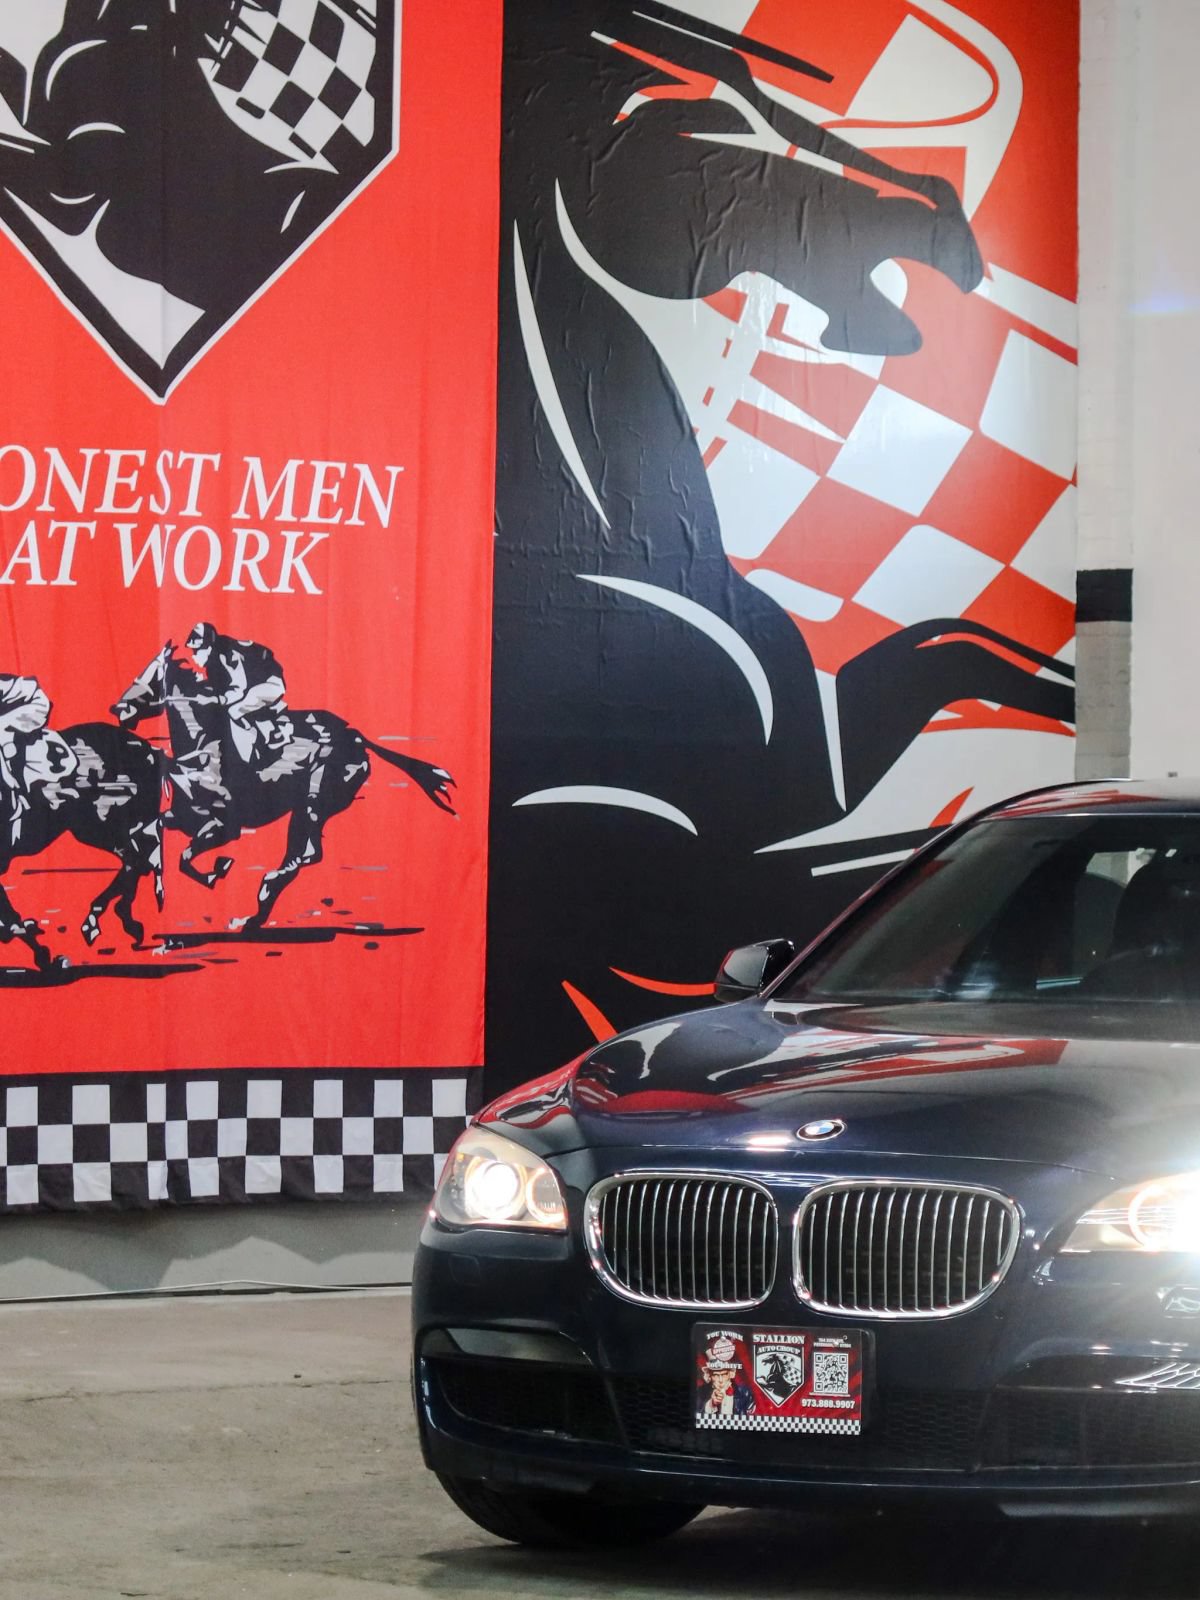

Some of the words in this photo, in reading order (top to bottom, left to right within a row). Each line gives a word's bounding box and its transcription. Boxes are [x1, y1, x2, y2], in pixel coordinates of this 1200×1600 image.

[232, 456, 404, 529] MEN
[0, 519, 97, 586] AT
[113, 522, 330, 595] WORK
[706, 1331, 720, 1340] YOU
[721, 1330, 744, 1342] WORK
[753, 1334, 805, 1345] STALLION
[757, 1345, 776, 1354] AUTO
[776, 1345, 801, 1355] GROUP
[801, 1398, 856, 1409] 973.888.9907
